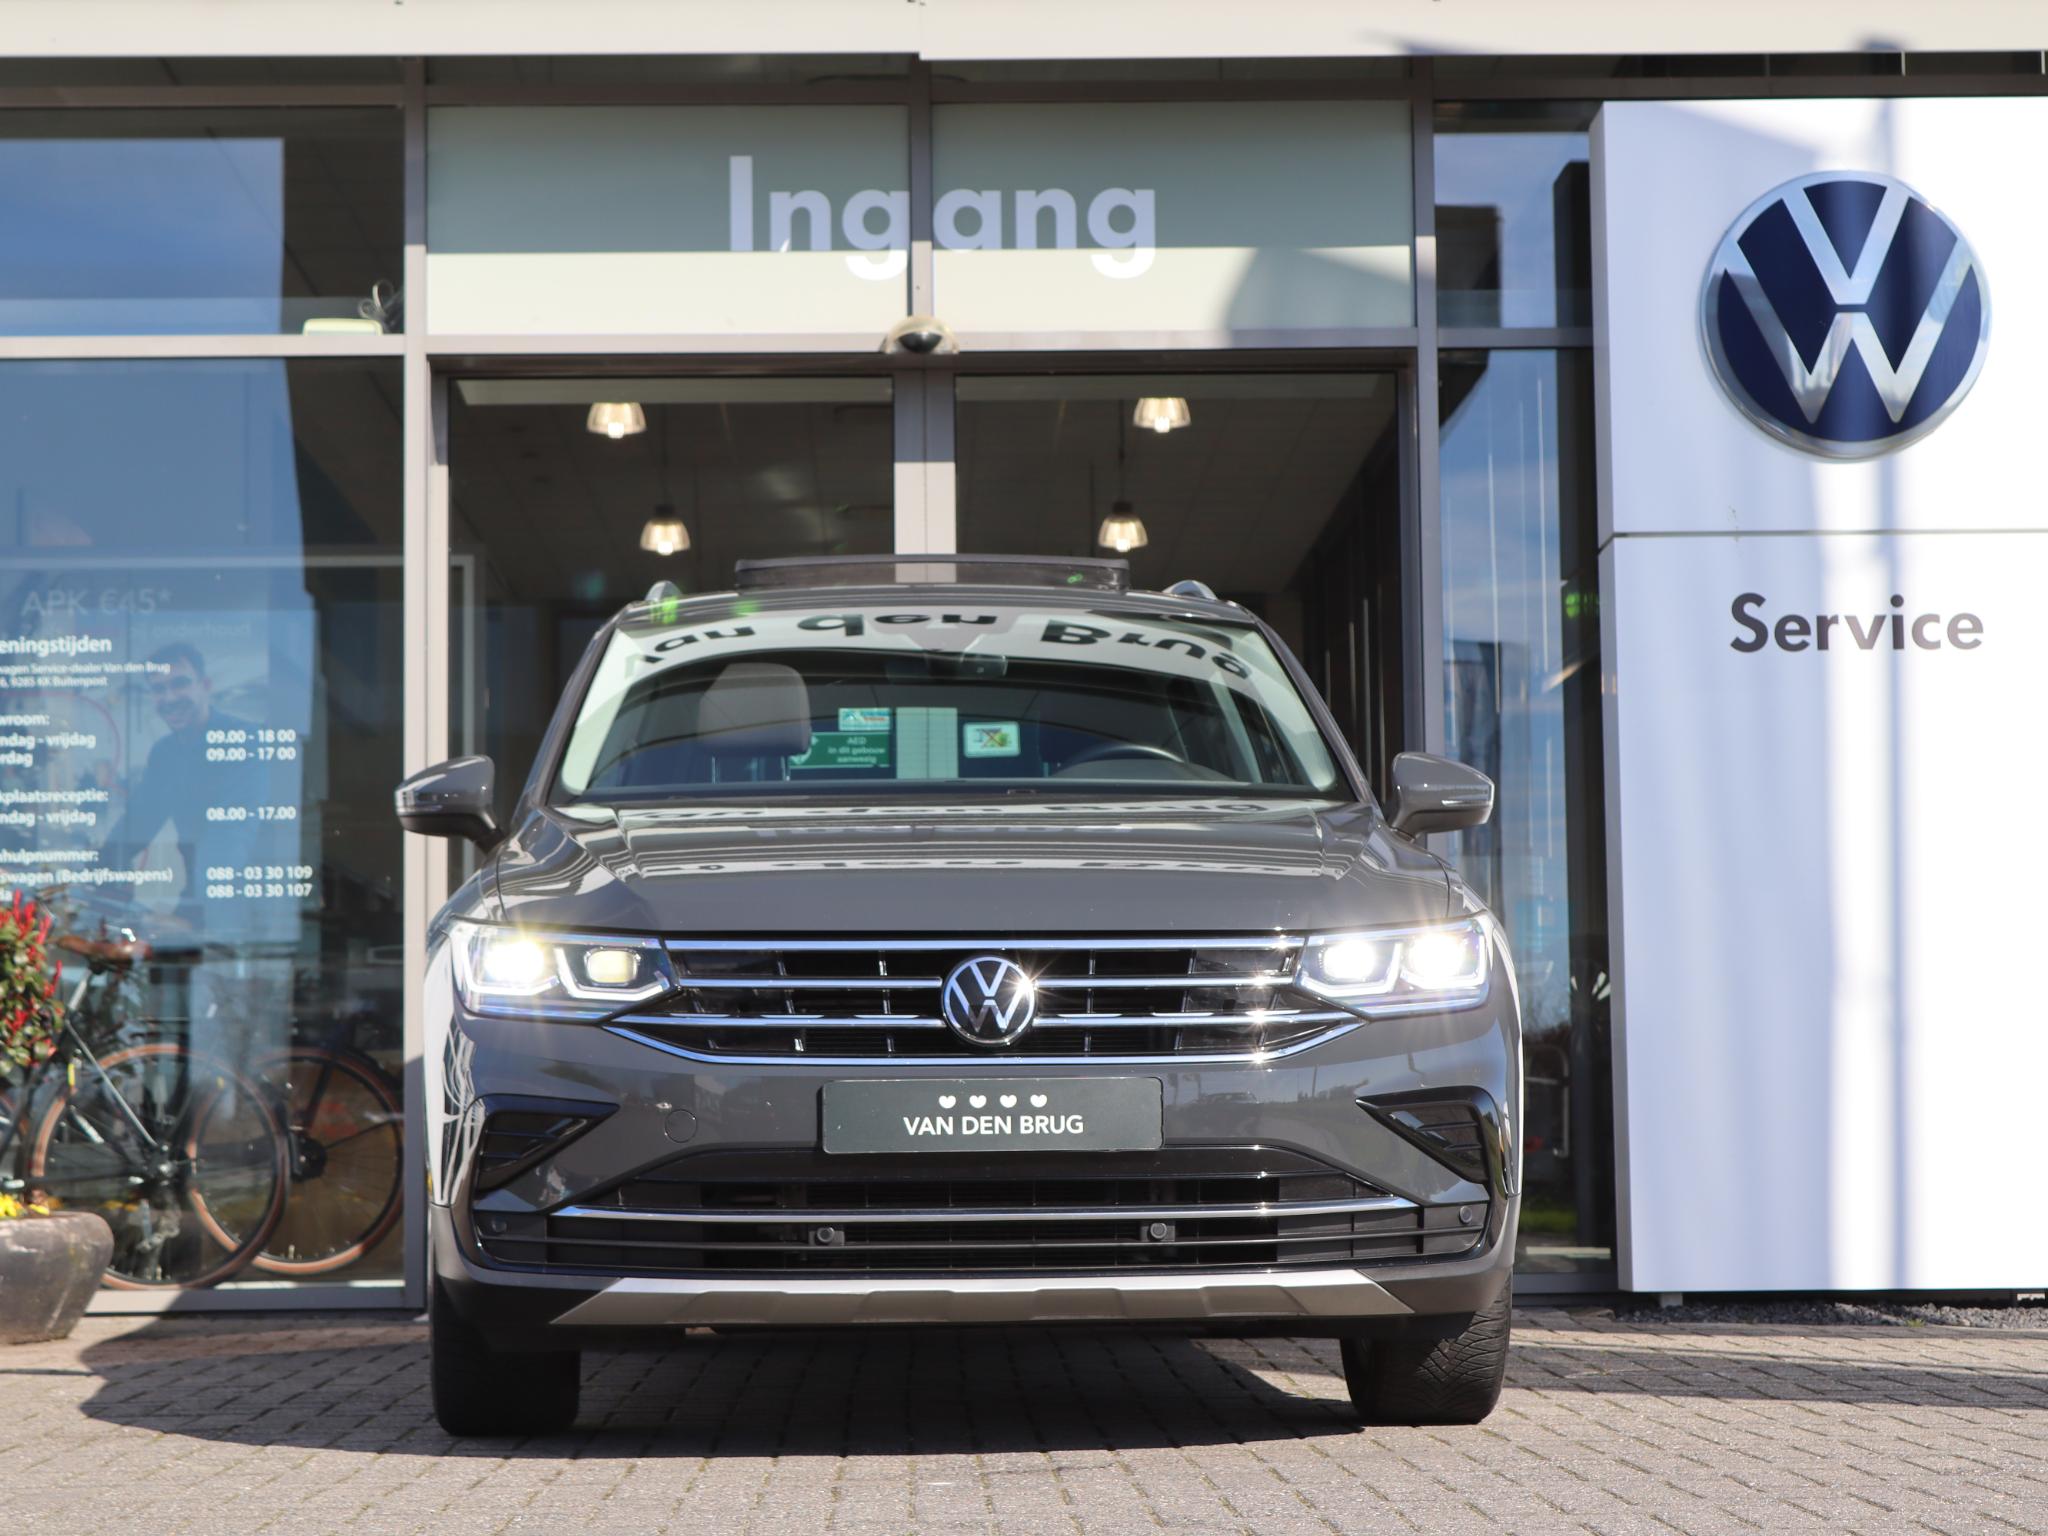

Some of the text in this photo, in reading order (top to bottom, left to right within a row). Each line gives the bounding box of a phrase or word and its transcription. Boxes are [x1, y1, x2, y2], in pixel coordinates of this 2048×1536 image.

[729, 155, 1156, 280] Ingang
[21, 589, 89, 616] APK
[1729, 592, 1984, 654] Service
[46, 731, 96, 749] vrijdag
[206, 729, 247, 744] 09.00
[46, 809, 96, 826] vrijdag
[258, 806, 297, 820] 17.00
[243, 865, 263, 880] 03
[264, 865, 284, 880] 30
[286, 865, 313, 880] 109
[243, 884, 263, 898] 03
[264, 883, 284, 898] 30
[286, 882, 313, 897] 107
[903, 1114, 1085, 1136] VAN DEN BRUG
